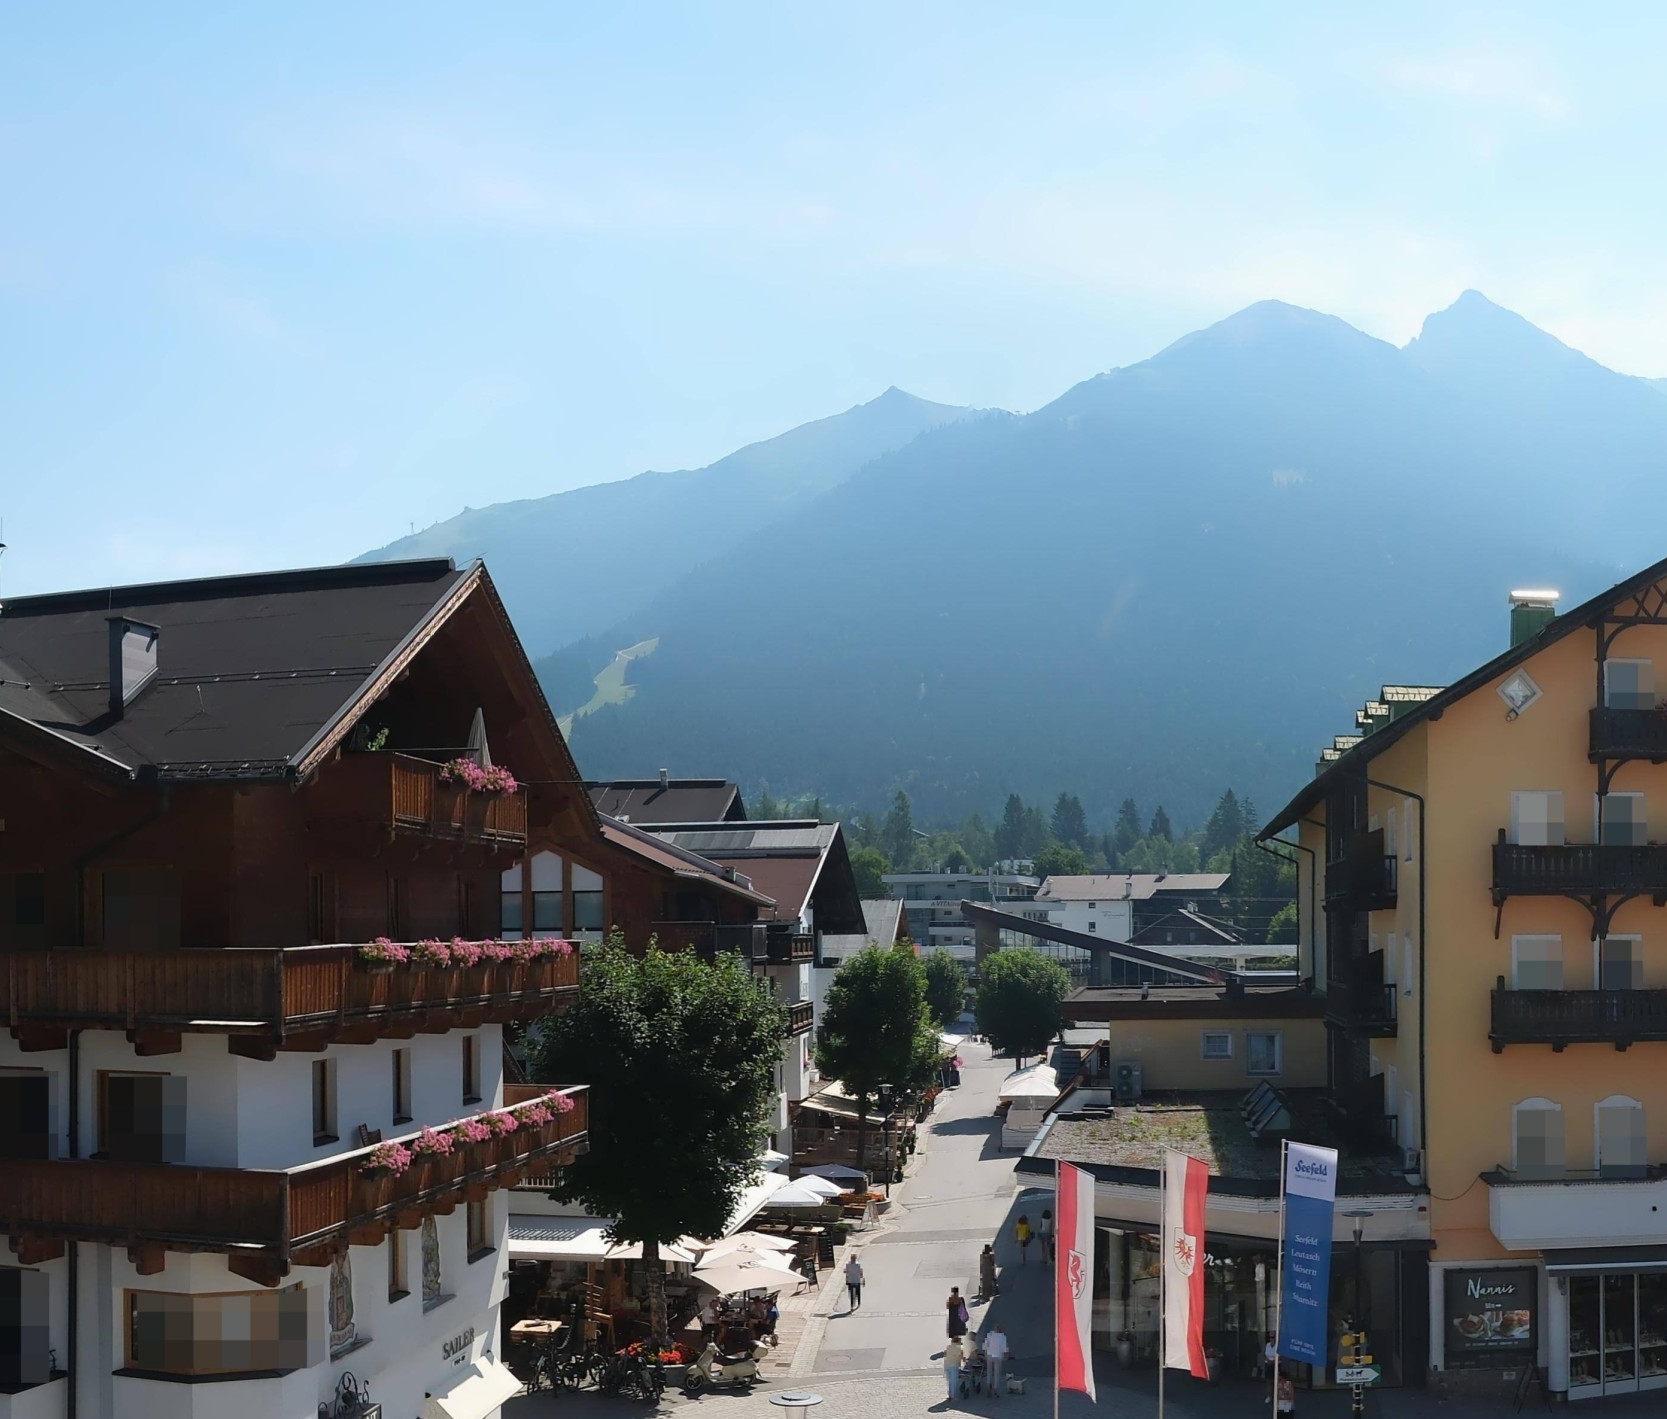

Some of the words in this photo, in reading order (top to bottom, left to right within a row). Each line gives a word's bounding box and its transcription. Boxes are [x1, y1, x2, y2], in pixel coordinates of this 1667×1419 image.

[1294, 1159, 1328, 1177] Seefeld
[1295, 1234, 1318, 1246] Seefeld
[1291, 1249, 1321, 1261] Leutasch
[1292, 1263, 1318, 1276] Mösern
[1295, 1279, 1312, 1291] Reith
[1467, 1276, 1515, 1299] Nannis
[442, 1327, 475, 1361] SAILER
